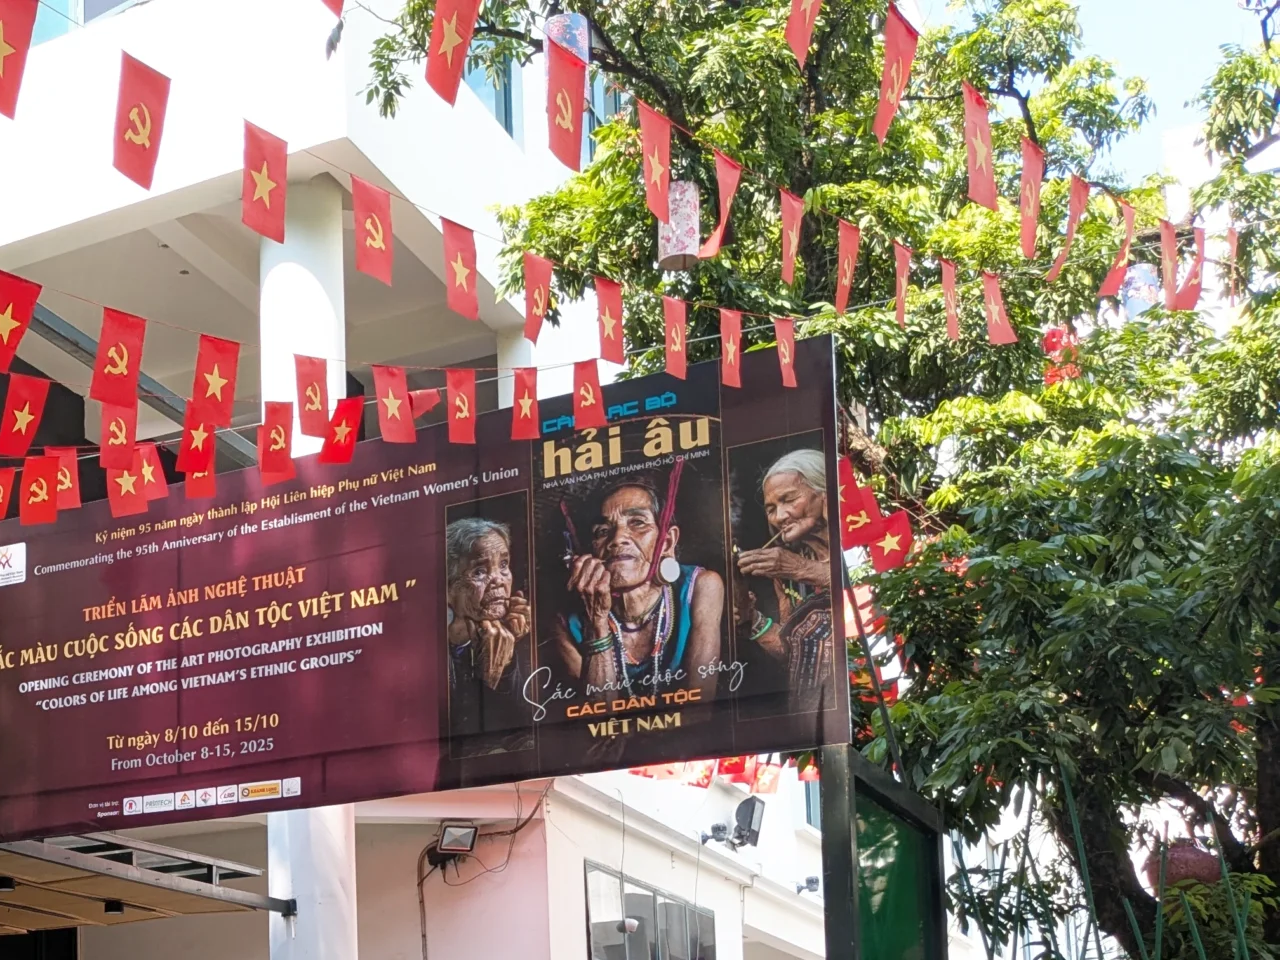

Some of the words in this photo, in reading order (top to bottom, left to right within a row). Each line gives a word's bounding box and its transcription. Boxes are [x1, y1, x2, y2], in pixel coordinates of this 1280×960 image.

[646, 392, 676, 410] BỘ
[543, 425, 621, 478] hải
[643, 417, 710, 457] âu
[34, 553, 114, 576] Commemorating
[117, 548, 132, 560] the
[135, 541, 159, 556] 95th
[162, 529, 224, 551] Anniversary
[227, 522, 238, 537] of
[240, 522, 258, 535] the
[261, 508, 331, 531] Establisment
[335, 503, 346, 516] of
[349, 500, 368, 513] the
[371, 488, 420, 507] Vietnam
[423, 475, 479, 496] Women’s
[482, 467, 519, 483] Union
[111, 526, 136, 541] niệm
[138, 523, 152, 534] 95
[155, 519, 177, 531] năm
[179, 511, 204, 529] ngày
[207, 504, 238, 521] thành
[241, 497, 258, 515] lập
[261, 494, 280, 511] Hội
[284, 490, 307, 504] Liên
[310, 485, 335, 501] hiệp
[338, 480, 360, 492] Phụ
[362, 474, 378, 486] nữ
[381, 468, 404, 483] Việt
[408, 462, 437, 476] Nam
[83, 597, 127, 622] TRIỂN
[132, 594, 162, 614] LÃM
[166, 588, 199, 607] ẢNH
[204, 575, 247, 601] NGHỆ
[252, 566, 306, 592] THUẬT
[20, 642, 58, 667] MÀU
[64, 634, 110, 659] CUỘC
[114, 622, 164, 650] SỐNG
[169, 615, 204, 640] CÁC
[209, 609, 249, 634] DÂN
[255, 601, 293, 628] TỘC
[298, 591, 344, 619] VIỆT
[350, 583, 399, 609] NAM
[19, 675, 69, 694] OPENING
[72, 665, 134, 685] CEREMONY
[137, 662, 153, 674] OF
[155, 658, 178, 672] THE
[181, 652, 204, 668] ART
[207, 637, 303, 663] PHOTOGRAPHY
[306, 622, 383, 647] EXHIBITION
[36, 693, 87, 711] “COLORS
[90, 692, 105, 702] OF
[108, 687, 128, 700] LIFE
[132, 680, 178, 697] AMONG
[182, 668, 247, 689] VIETNAM’S
[251, 661, 297, 679] ETHNIC
[300, 649, 362, 671] GROUPS”
[523, 667, 576, 721] Sắc
[567, 702, 606, 718] CÁC
[612, 693, 656, 712] DÂN
[662, 688, 702, 706] TỘC
[107, 734, 125, 750] Từ
[127, 731, 160, 750] ngày
[164, 725, 198, 743] 8/10
[203, 718, 229, 737] đến
[235, 713, 279, 733] 15/10
[588, 717, 632, 739] VIỆT
[637, 712, 682, 732] NAM
[111, 758, 142, 771] From
[146, 750, 196, 767] October
[200, 743, 235, 759] 8-15,
[240, 738, 274, 754] 2025
